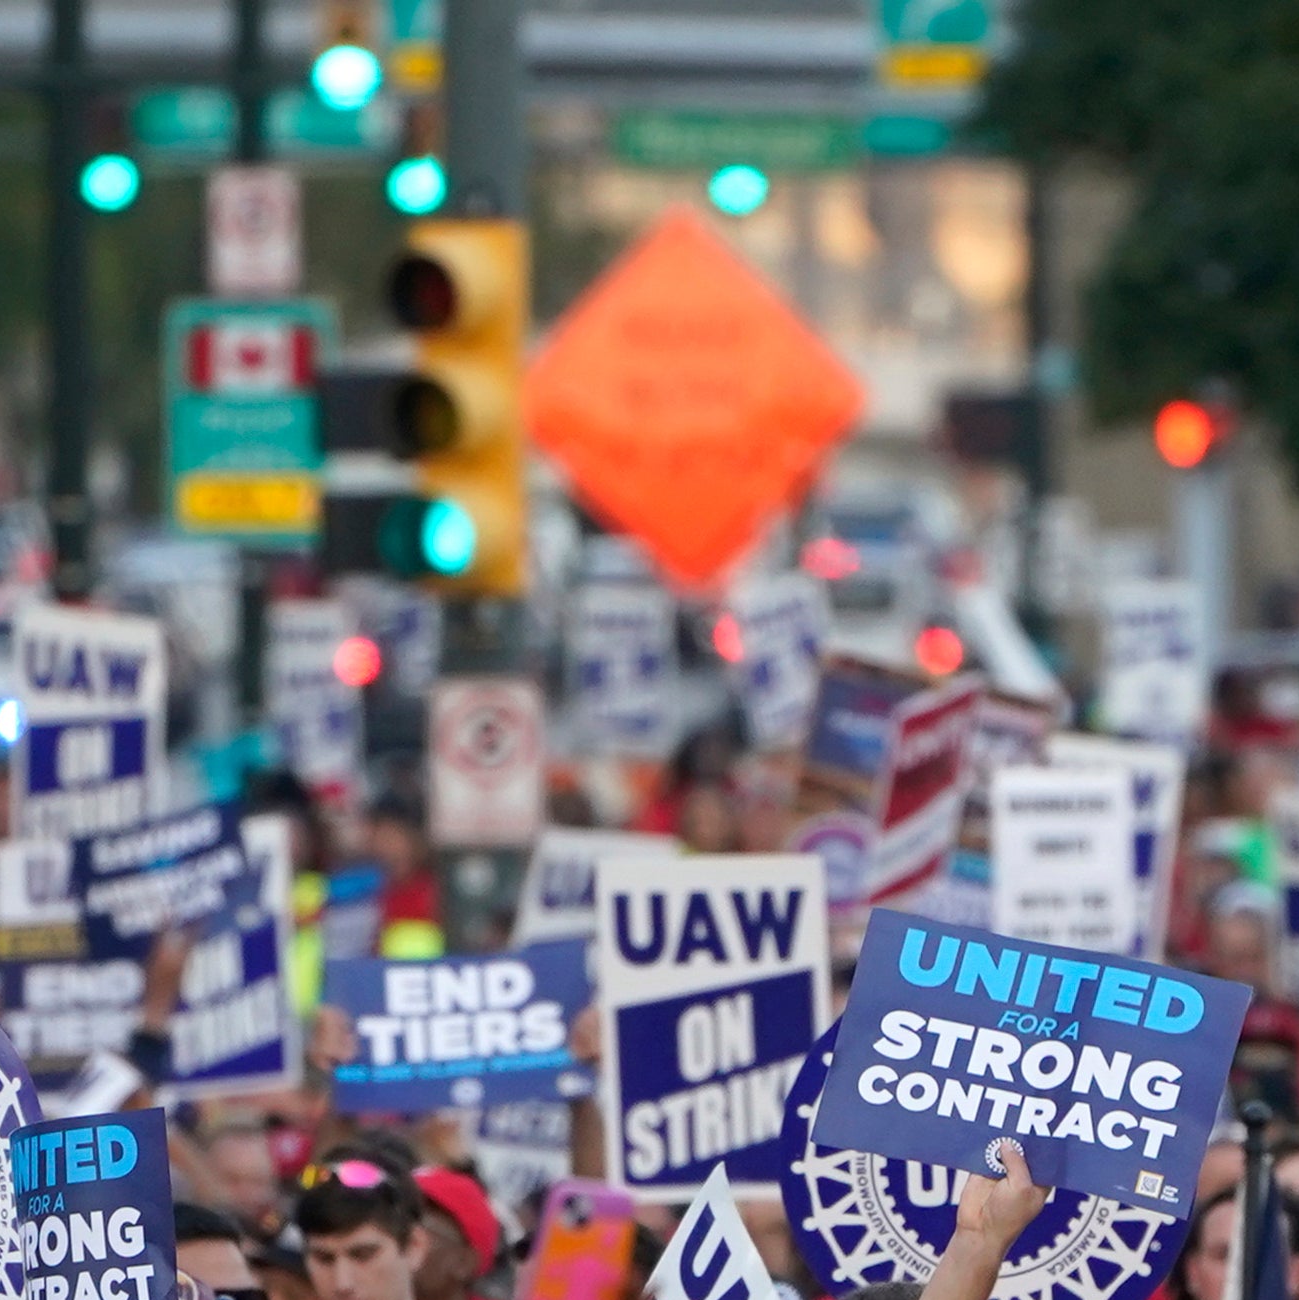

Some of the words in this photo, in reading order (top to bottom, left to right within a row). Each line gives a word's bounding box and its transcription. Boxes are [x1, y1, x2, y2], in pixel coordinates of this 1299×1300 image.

[614, 888, 805, 967] UAW
[384, 961, 535, 1016] END
[900, 927, 1206, 1035] UNITED
[357, 1001, 567, 1067] TIERS
[676, 992, 757, 1083] ON
[997, 1011, 1058, 1036] FOR
[1058, 1020, 1081, 1041] A
[873, 1009, 1183, 1112] STRONG
[625, 1053, 807, 1180] STRIK
[857, 1065, 1178, 1160] CONTRACT
[14, 1123, 139, 1200] NITED
[0, 1208, 9, 1228] OF
[27, 1195, 50, 1218] FOR
[52, 1191, 66, 1214] A
[855, 1154, 890, 1237] AUTOMOBIL
[1096, 1206, 1110, 1226] OF
[20, 1206, 146, 1272] RONG
[887, 1237, 932, 1277] UNITED
[1046, 1228, 1097, 1276] AMERICA
